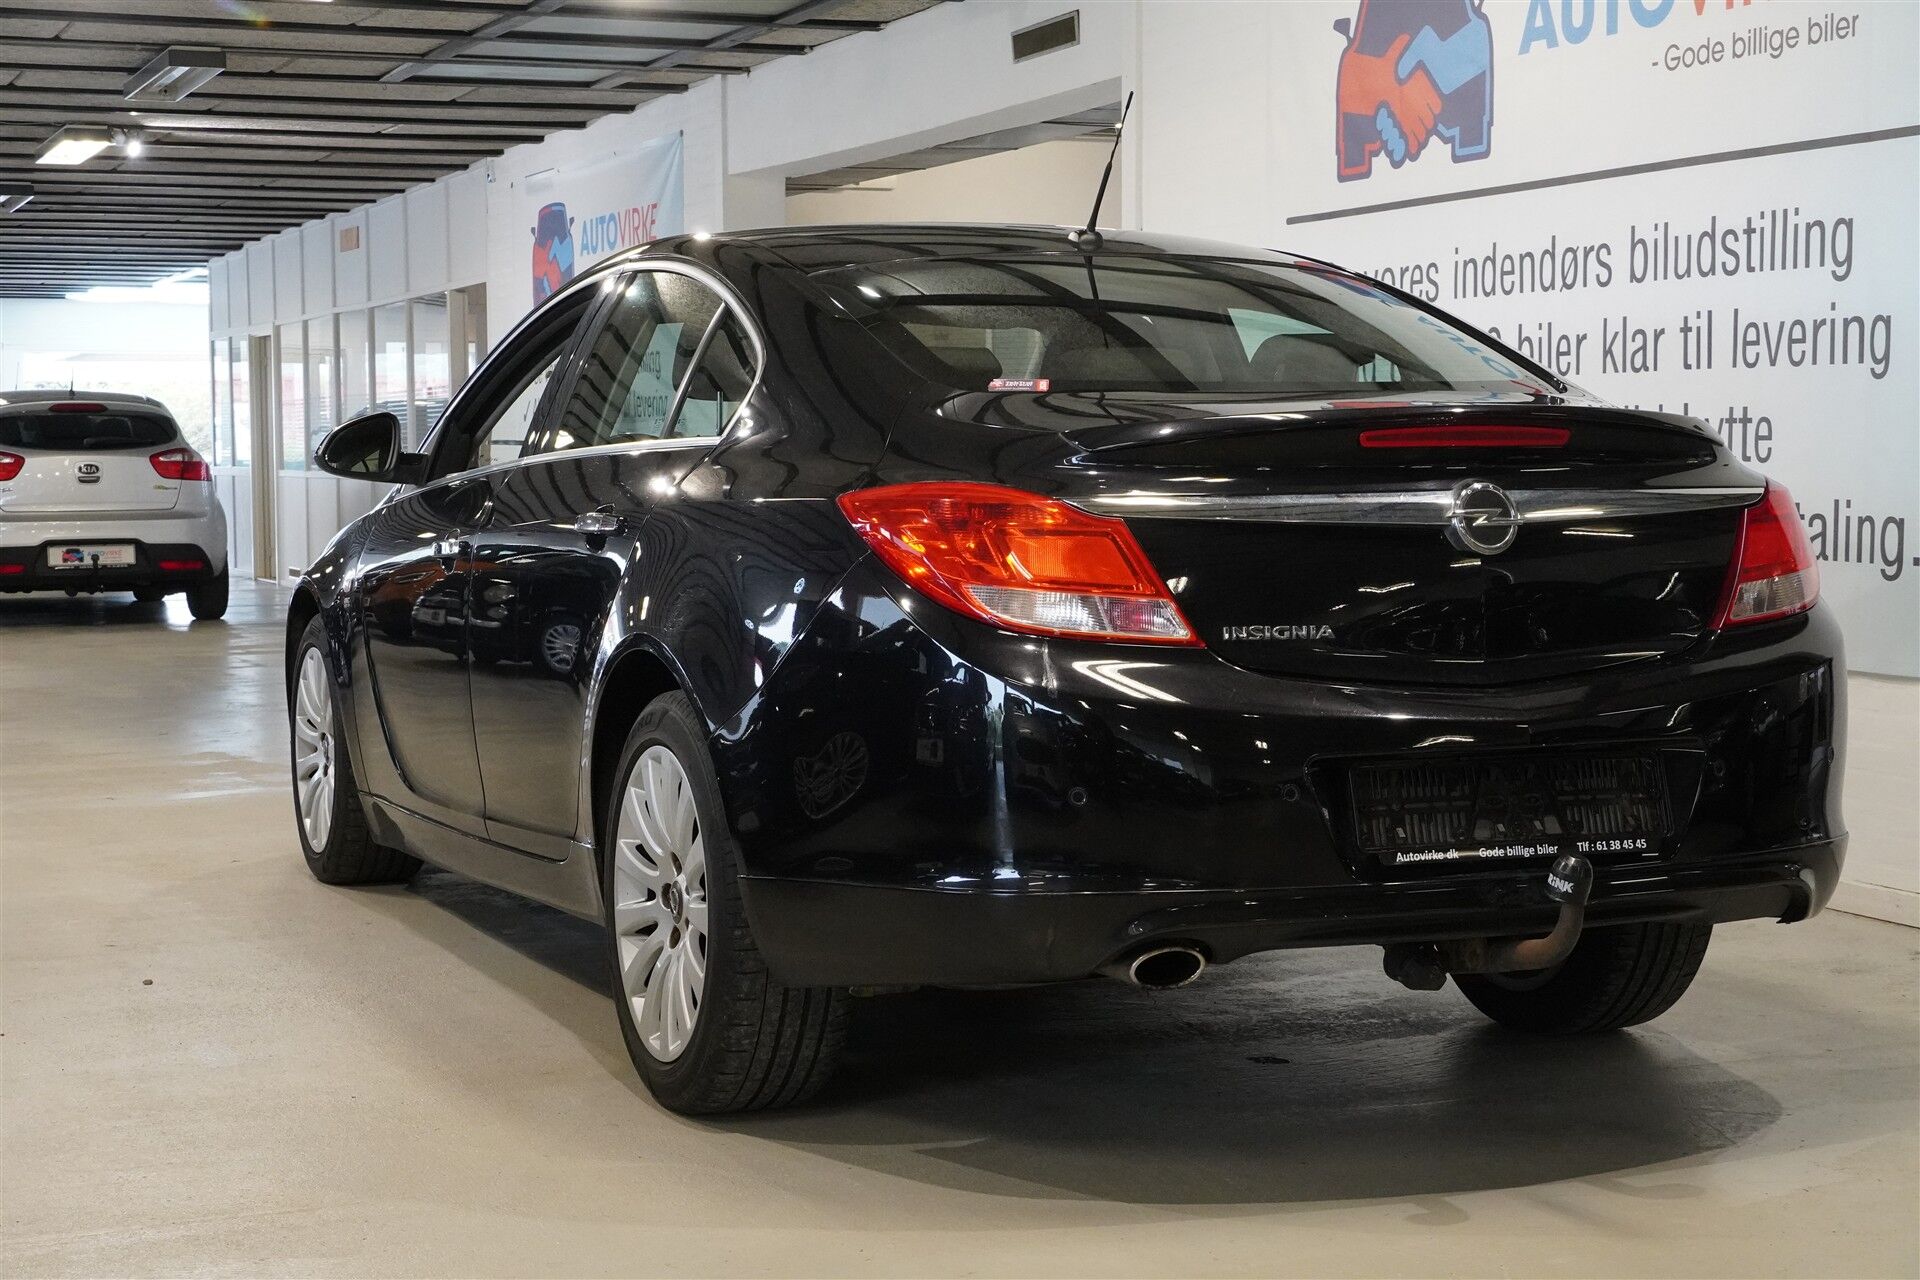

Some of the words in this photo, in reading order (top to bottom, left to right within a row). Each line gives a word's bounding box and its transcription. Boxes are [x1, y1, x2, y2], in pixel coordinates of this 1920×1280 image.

[1664, 38, 1725, 71] Gode
[1732, 25, 1800, 60] billige
[1807, 12, 1860, 47] biler
[580, 202, 658, 256] AUTOVIRKE
[1453, 235, 1613, 300] indendørs
[1629, 207, 1855, 283] biludstilling
[1601, 315, 1666, 375] klar
[1680, 309, 1713, 371] til
[1732, 302, 1893, 380] levering
[80, 462, 98, 474] KIA
[1222, 624, 1336, 641] INSIGNIA
[1478, 847, 1505, 858] Gode
[1507, 844, 1535, 858] billige
[1536, 843, 1559, 855] biler
[1596, 840, 1608, 851] 61
[1609, 840, 1621, 850] 38
[1622, 839, 1634, 849] 45
[1635, 838, 1647, 849] 45
